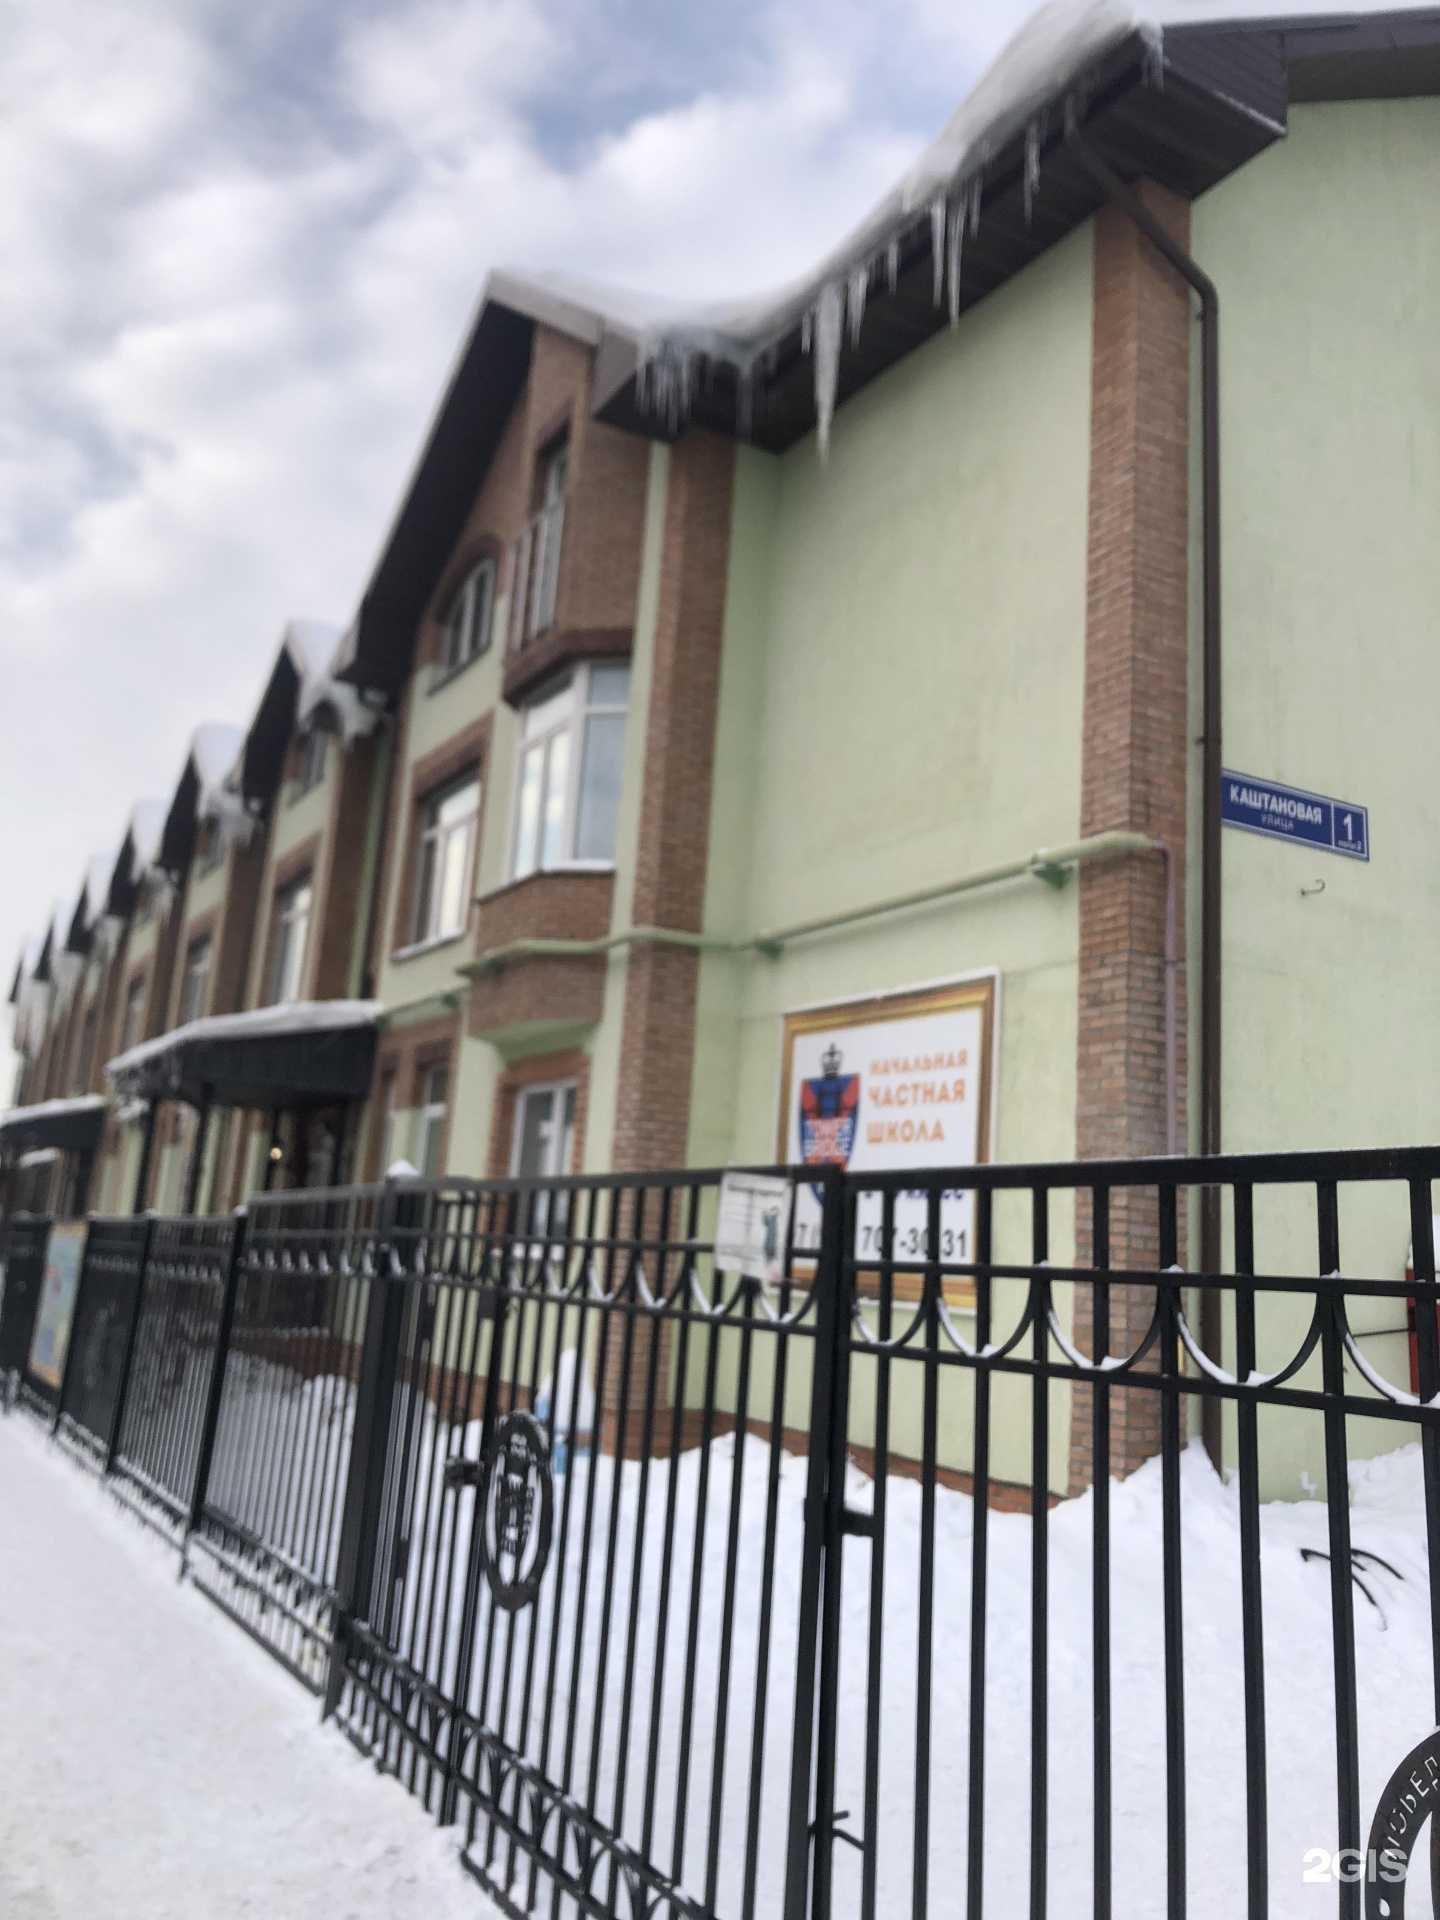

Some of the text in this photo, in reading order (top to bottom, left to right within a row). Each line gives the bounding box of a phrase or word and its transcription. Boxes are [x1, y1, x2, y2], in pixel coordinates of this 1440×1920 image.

[1230, 784, 1322, 824] КАШТАНОВАЯ
[1343, 813, 1353, 841] 1
[869, 1049, 968, 1076] НАЧАЛЬНАЯ
[868, 1078, 967, 1108] ЧАСТНАЯ
[867, 1118, 945, 1144] ШКОЛА
